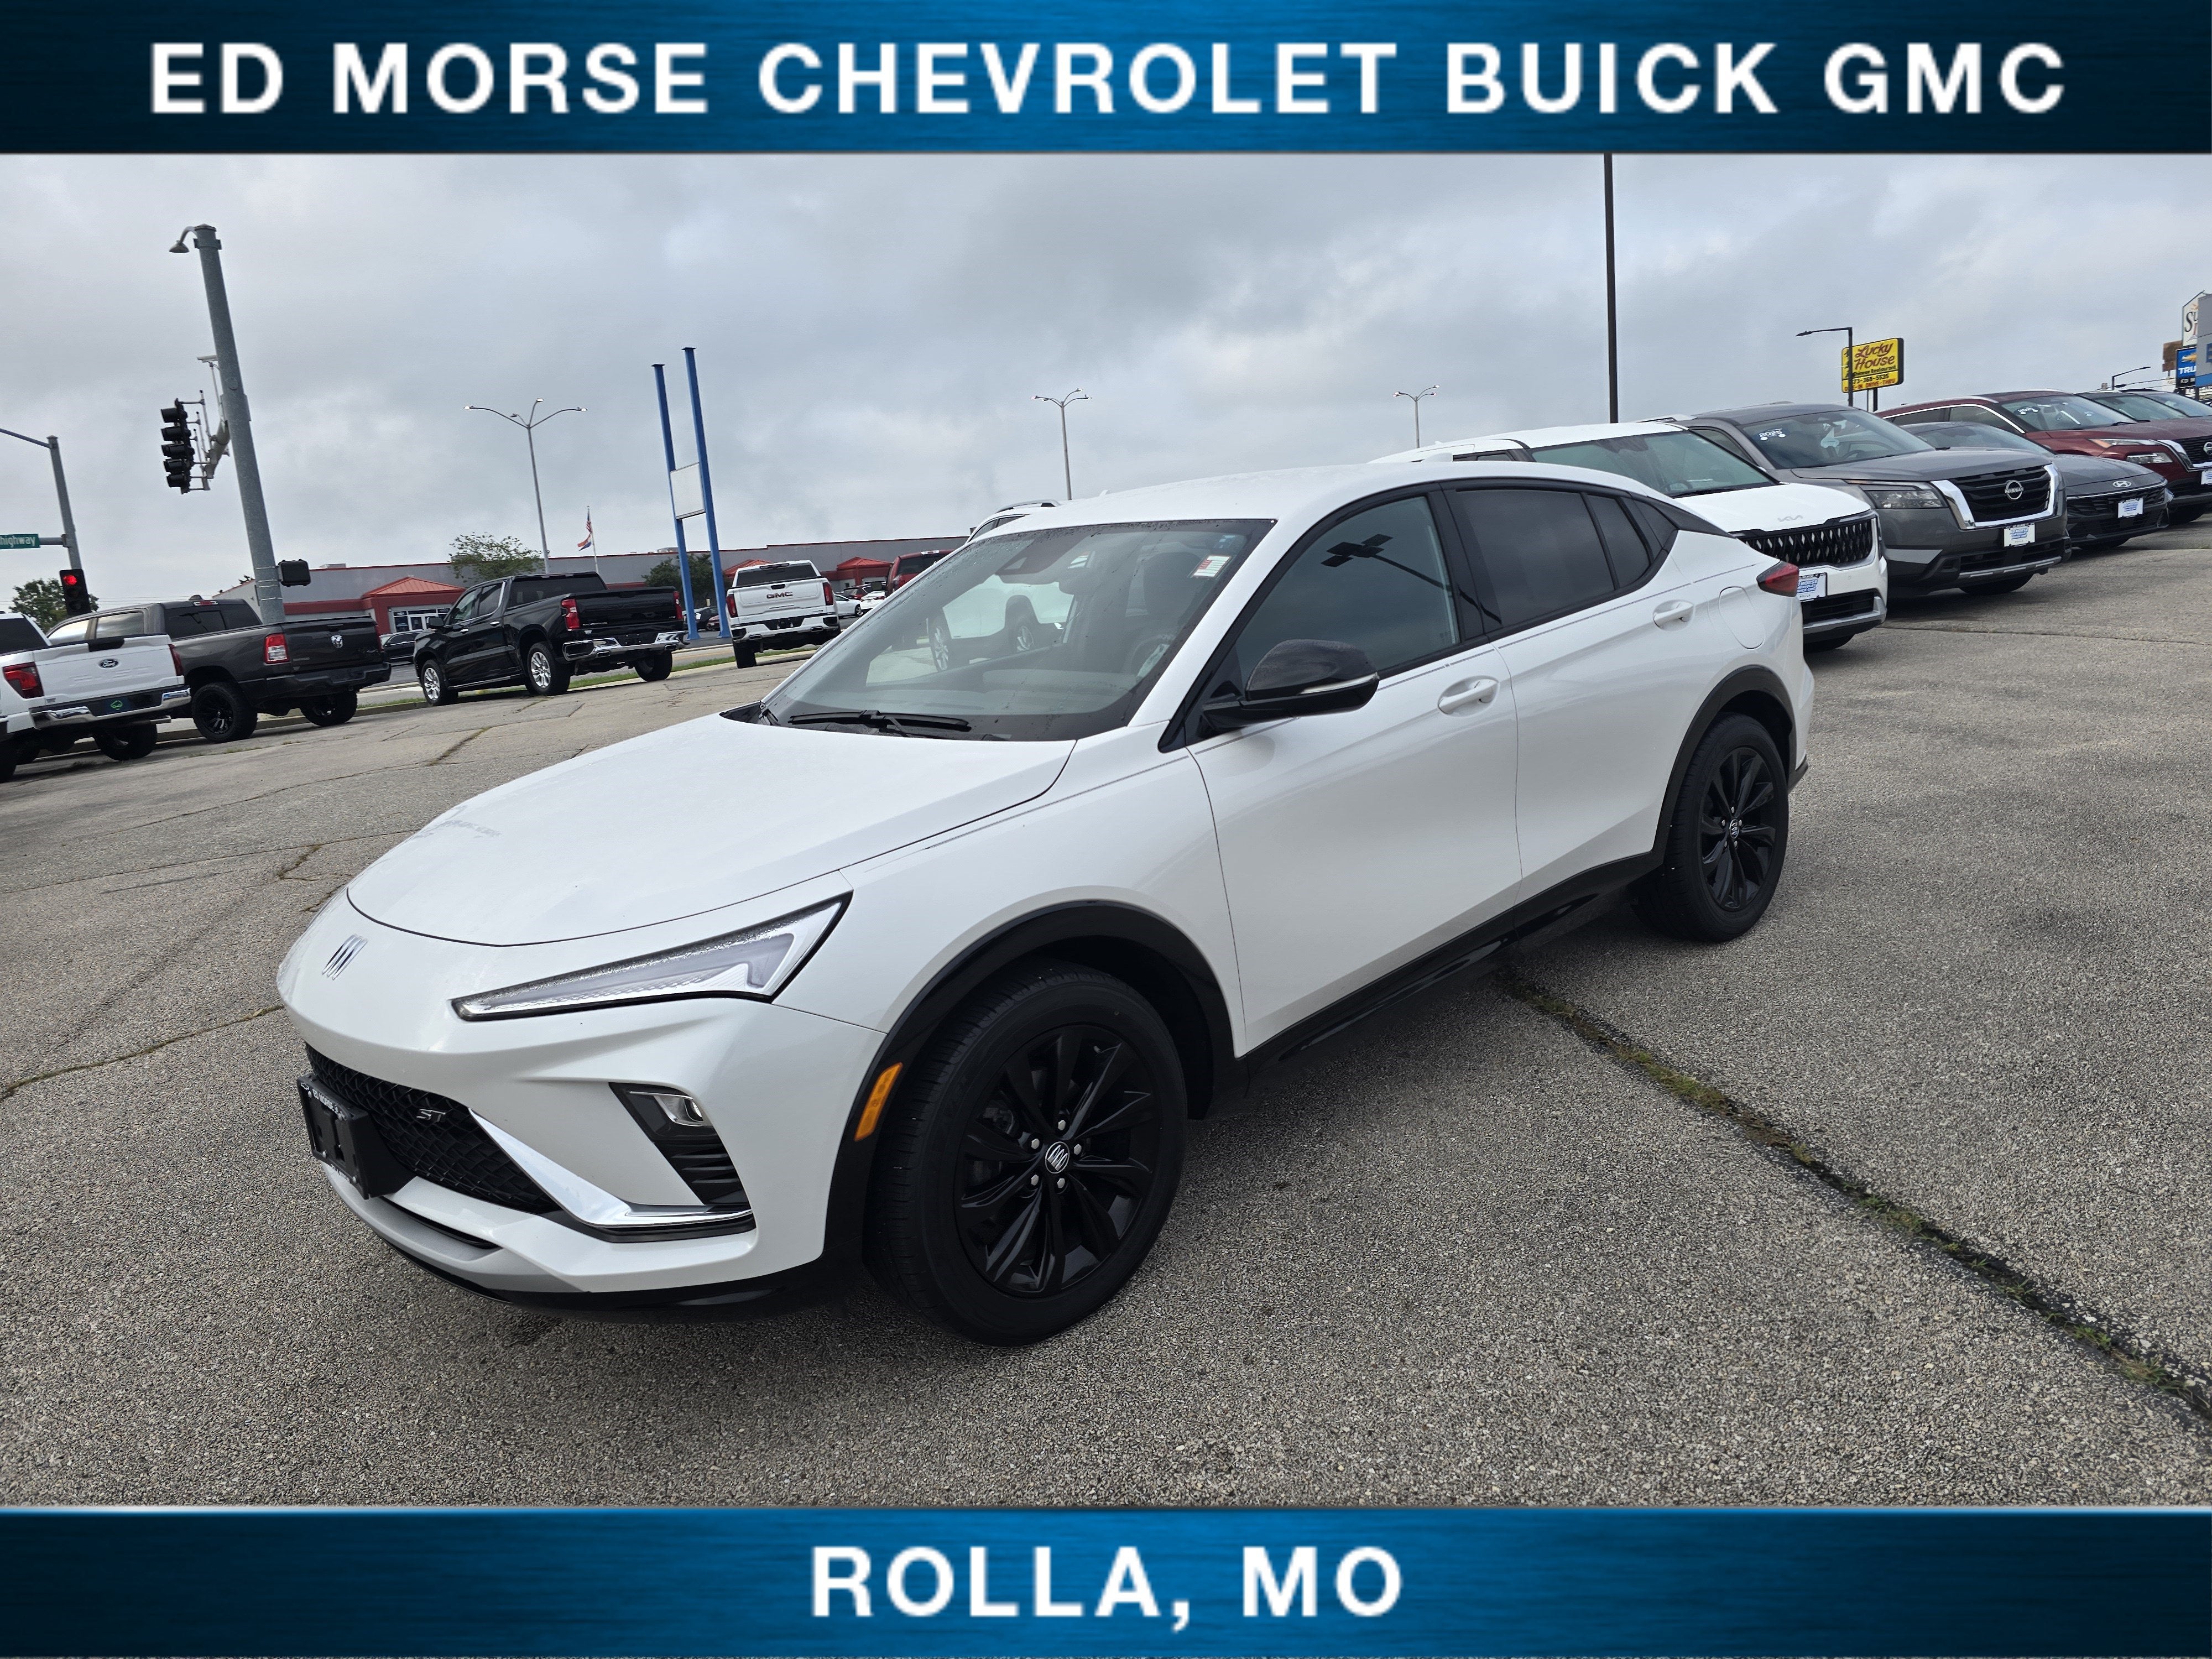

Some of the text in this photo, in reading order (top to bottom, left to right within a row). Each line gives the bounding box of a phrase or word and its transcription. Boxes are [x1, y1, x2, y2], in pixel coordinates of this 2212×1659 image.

[1855, 343, 1893, 358] Lucky
[1854, 356, 1896, 370] House
[416, 1108, 447, 1123] ST
